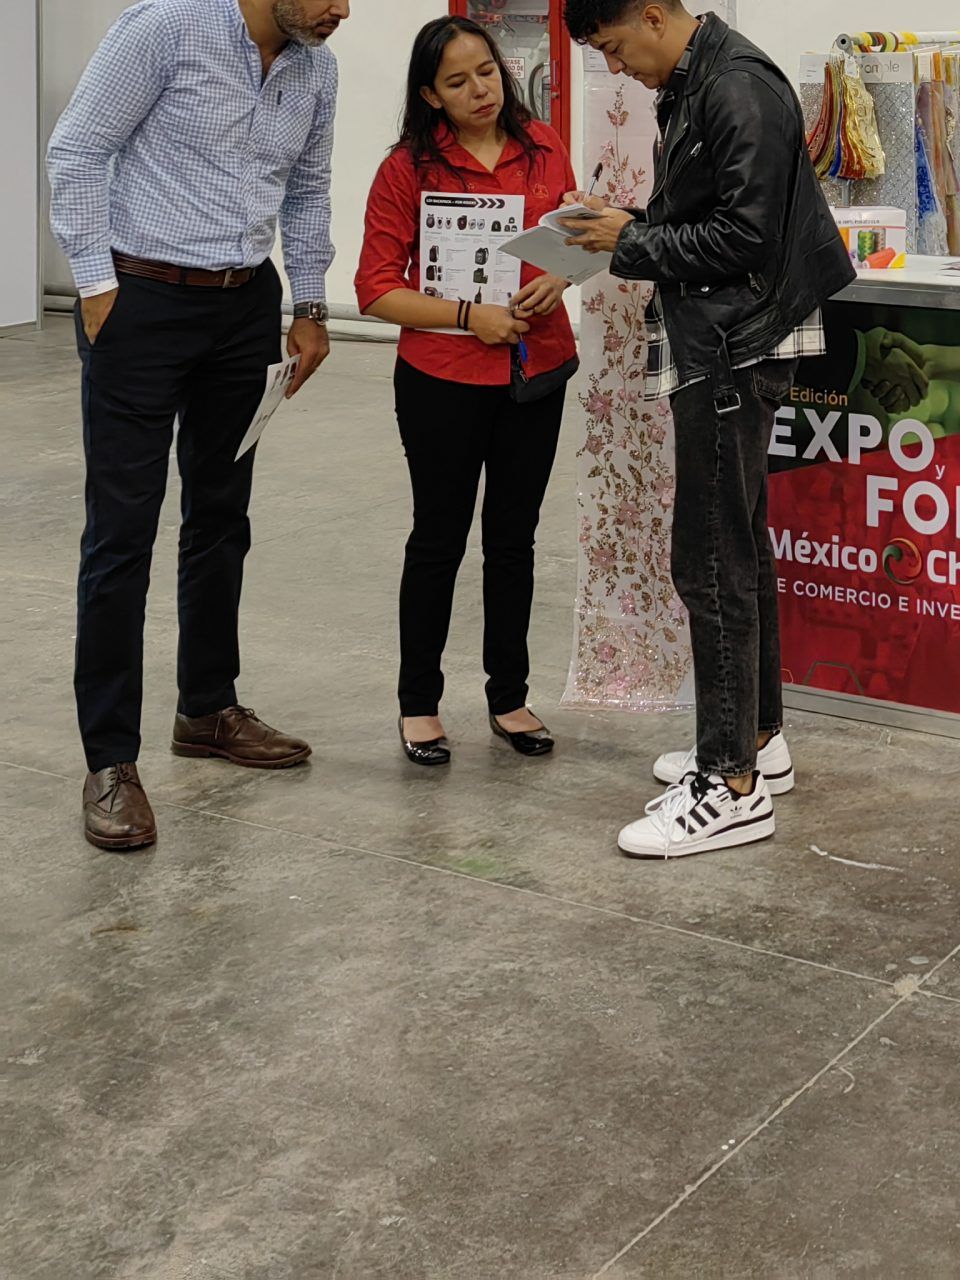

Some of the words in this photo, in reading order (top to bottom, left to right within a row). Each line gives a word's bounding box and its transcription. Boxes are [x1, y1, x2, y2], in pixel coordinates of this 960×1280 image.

[790, 387, 848, 406] Edición
[767, 406, 935, 472] EXPO
[935, 465, 945, 480] y
[768, 527, 878, 573] México
[793, 580, 891, 609] COMERCIO
[899, 597, 909, 612] E
